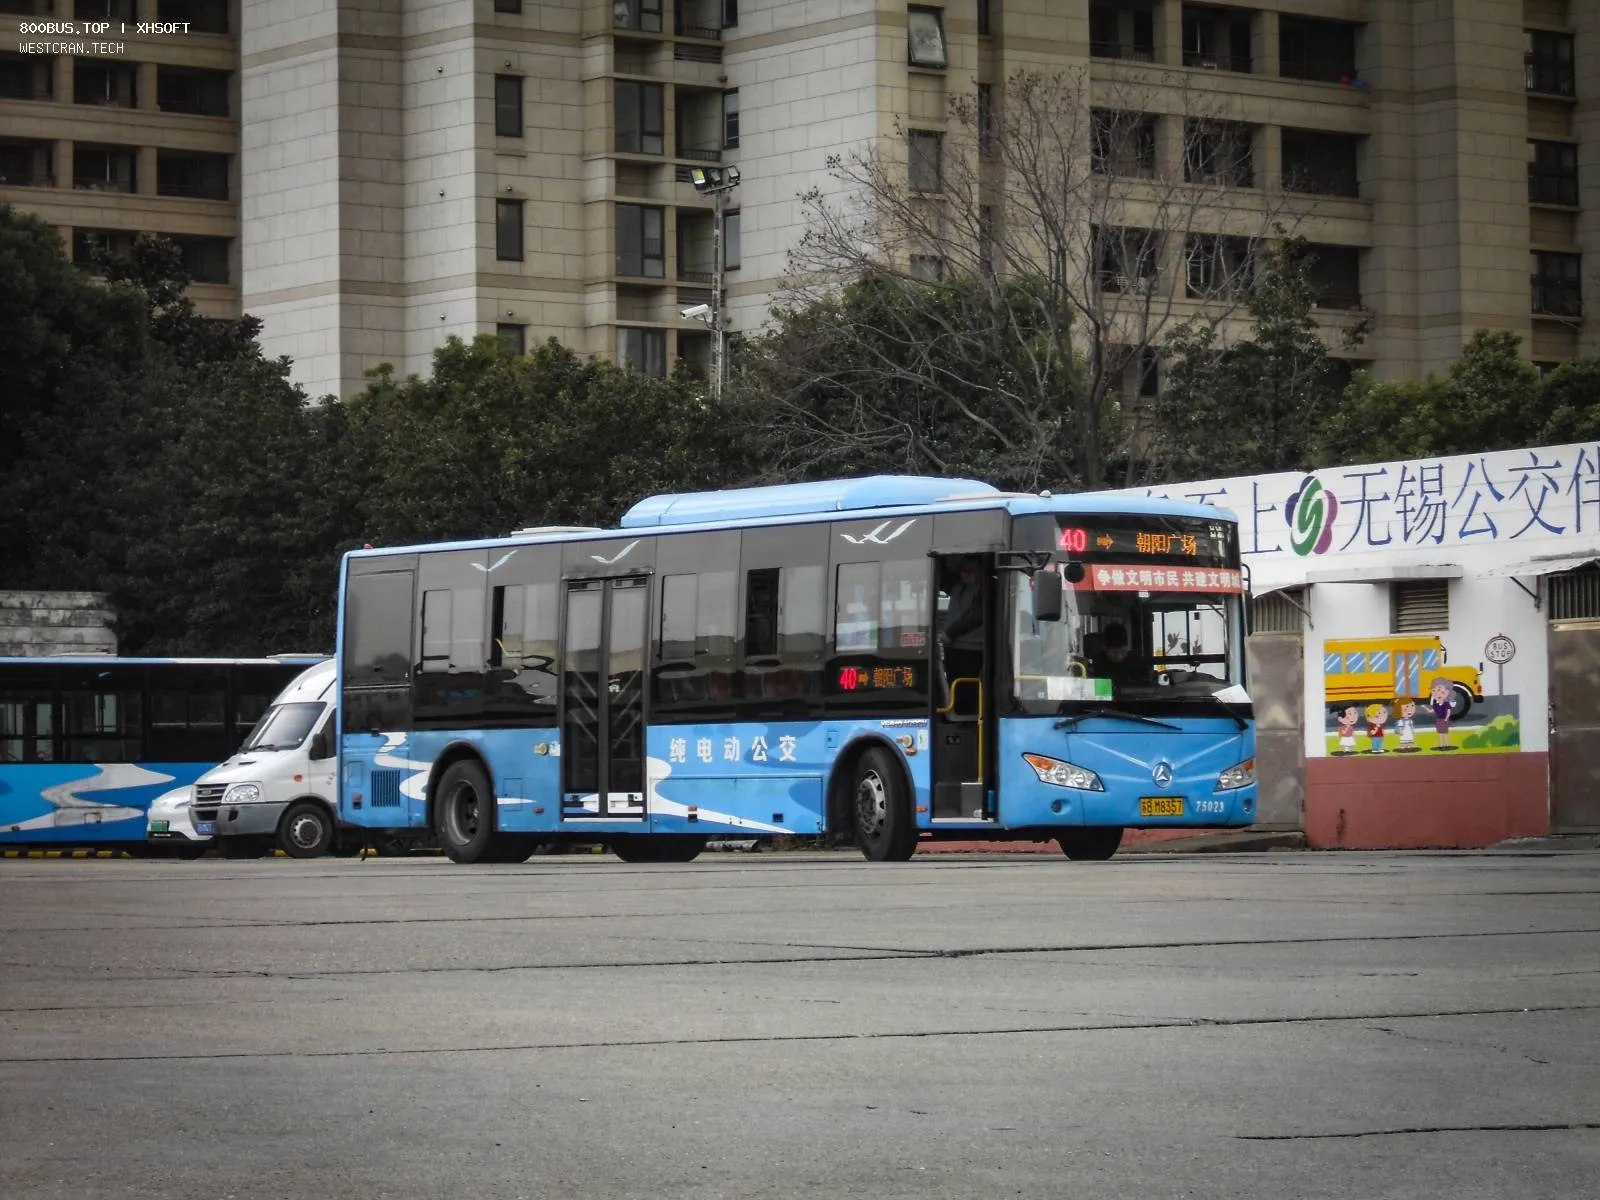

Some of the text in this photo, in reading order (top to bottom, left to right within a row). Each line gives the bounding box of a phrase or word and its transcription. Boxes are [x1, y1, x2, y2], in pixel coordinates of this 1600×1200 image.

[1060, 528, 1088, 552] 40
[1136, 532, 1197, 556] 朝阳广场
[1098, 569, 1179, 587] 争做文明市民
[1490, 650, 1511, 658] STOP
[1493, 642, 1508, 650] BUS
[840, 667, 857, 690] 40
[670, 735, 797, 763] 纯电动公交
